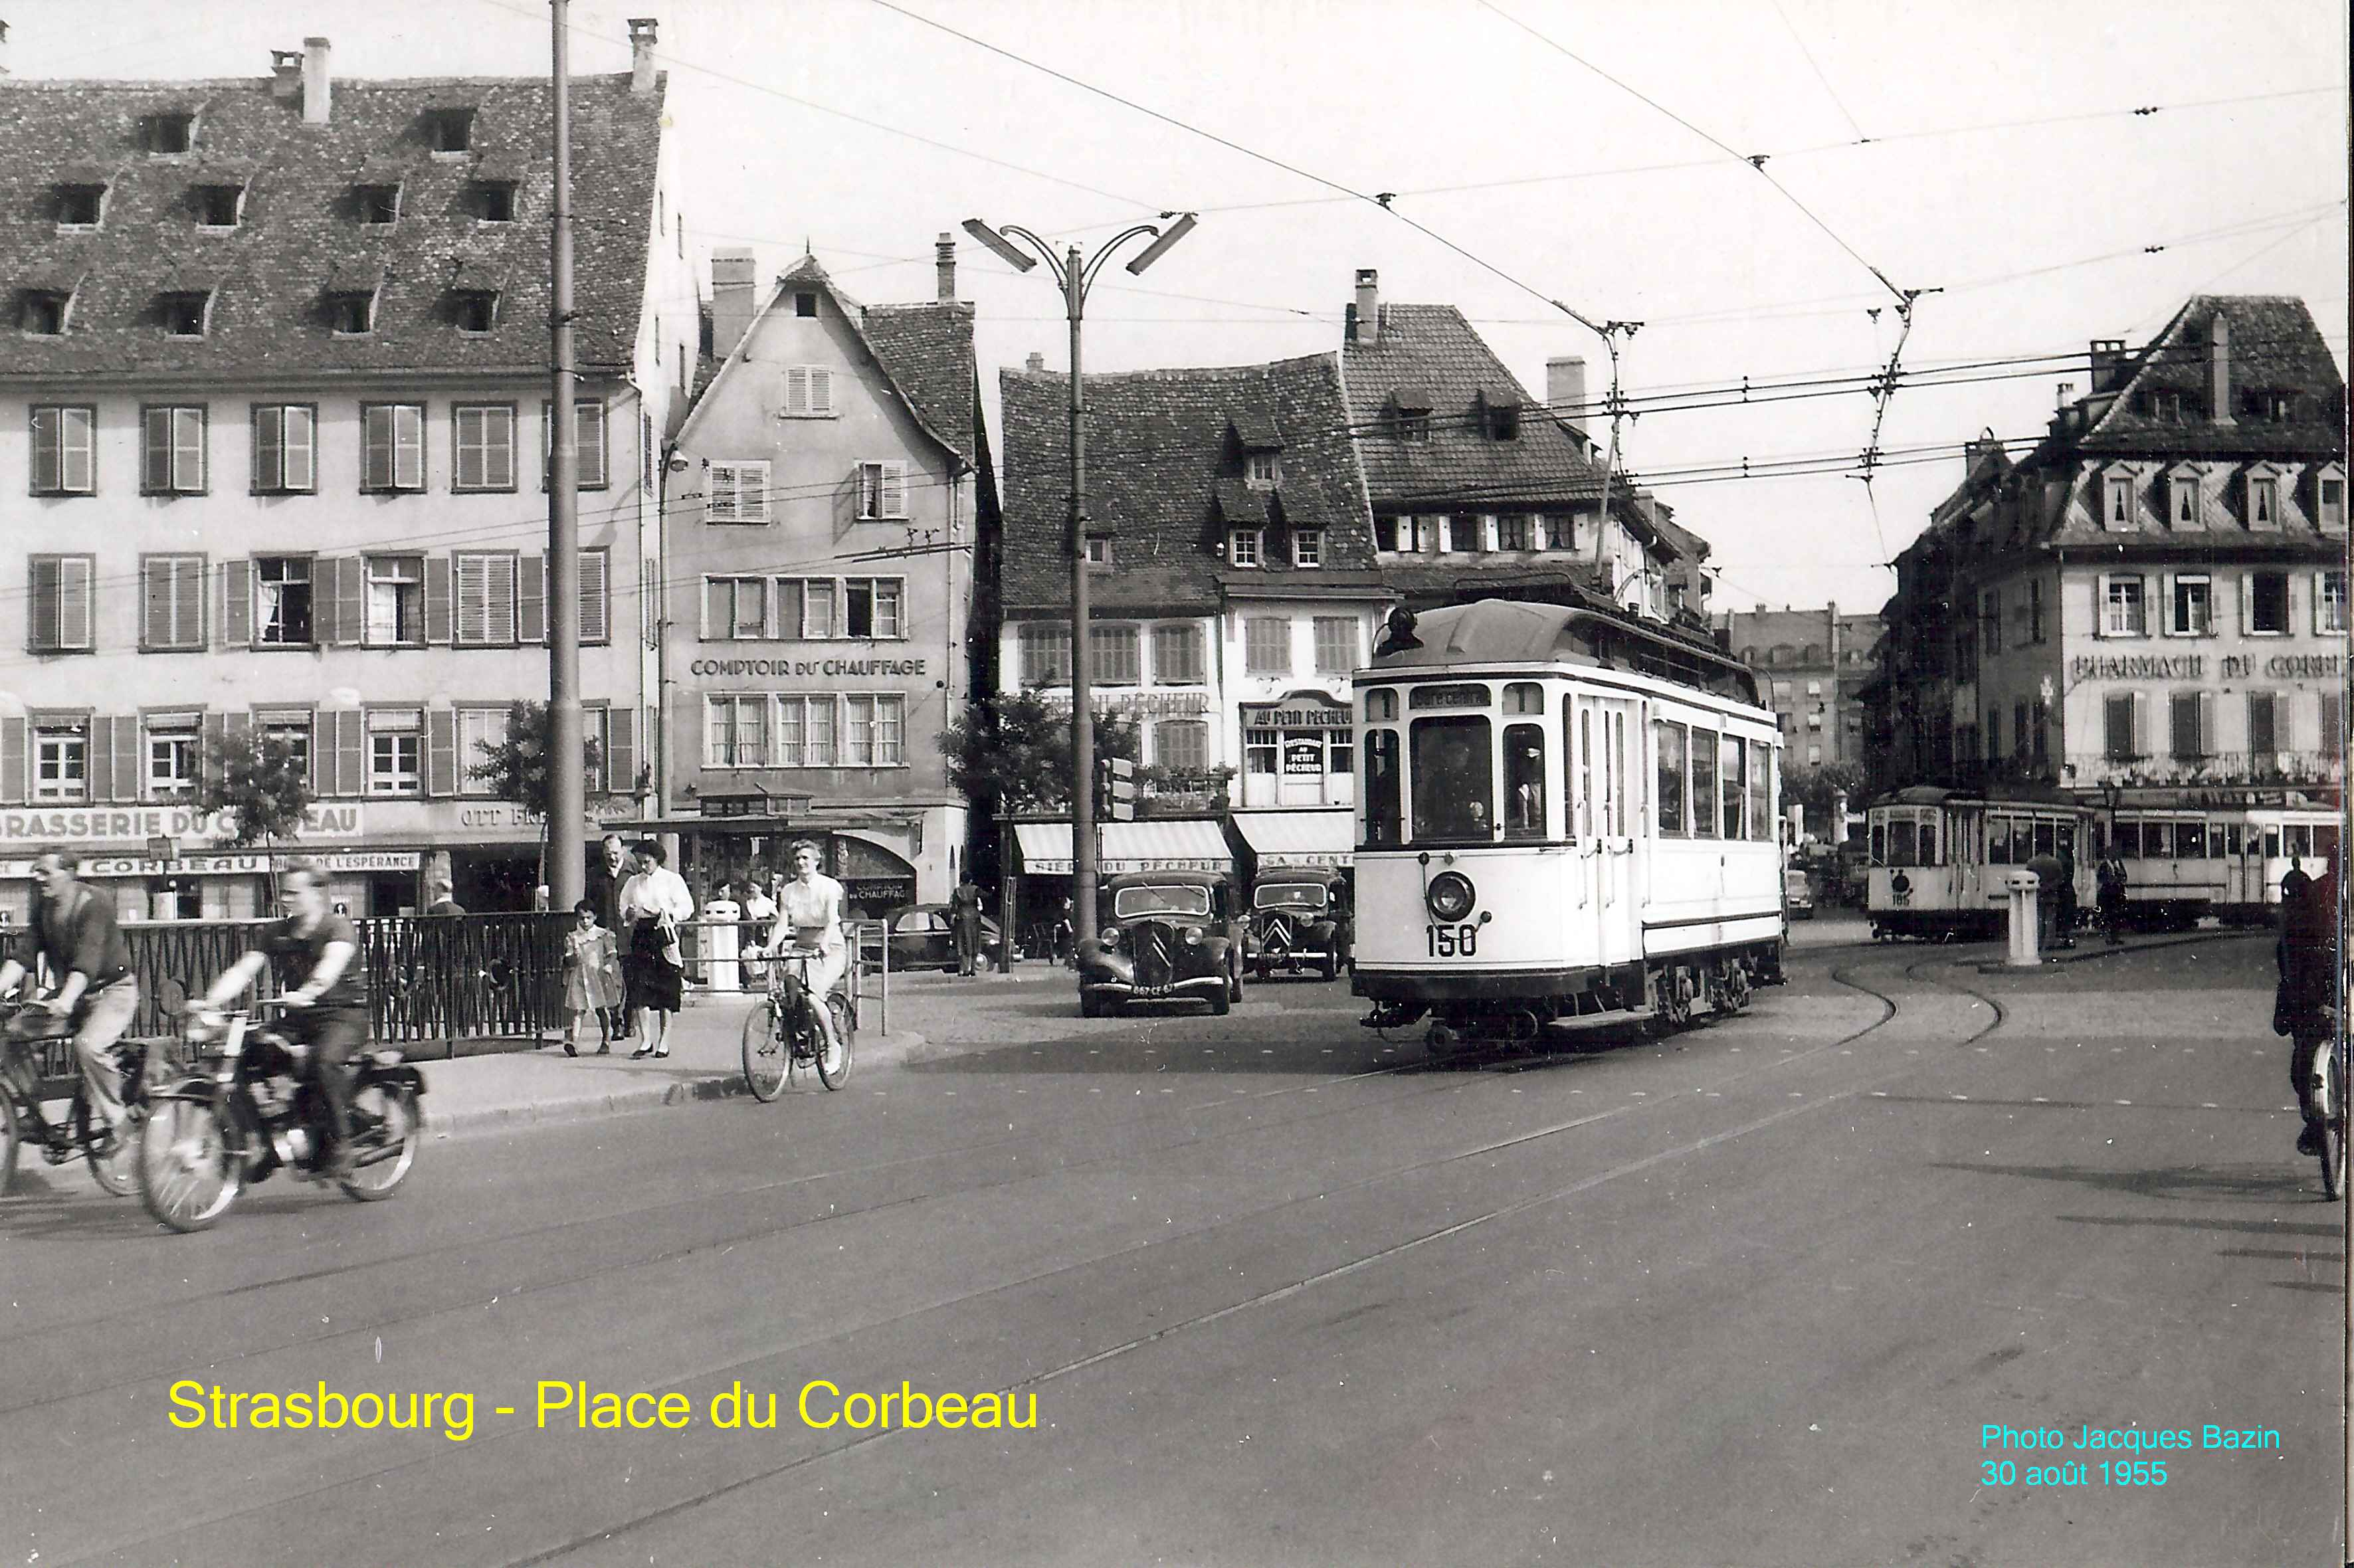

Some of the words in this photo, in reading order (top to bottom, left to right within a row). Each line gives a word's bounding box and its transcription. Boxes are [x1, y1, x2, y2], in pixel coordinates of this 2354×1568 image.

[690, 659, 789, 676] COMPTOIR
[795, 661, 820, 676] DU
[823, 659, 926, 676] CHAUFFAGE
[2222, 654, 2256, 678] DU
[1383, 690, 1391, 718] 1
[1516, 686, 1525, 712] 1
[1291, 753, 1316, 762] PETIT
[0, 812, 161, 838] RASSERIE
[172, 810, 208, 834] DU
[217, 807, 357, 833] CEAU
[461, 809, 502, 827] OTT
[91, 857, 258, 873] CORBEAU
[1104, 862, 1126, 871] DU
[1426, 924, 1476, 957] 150
